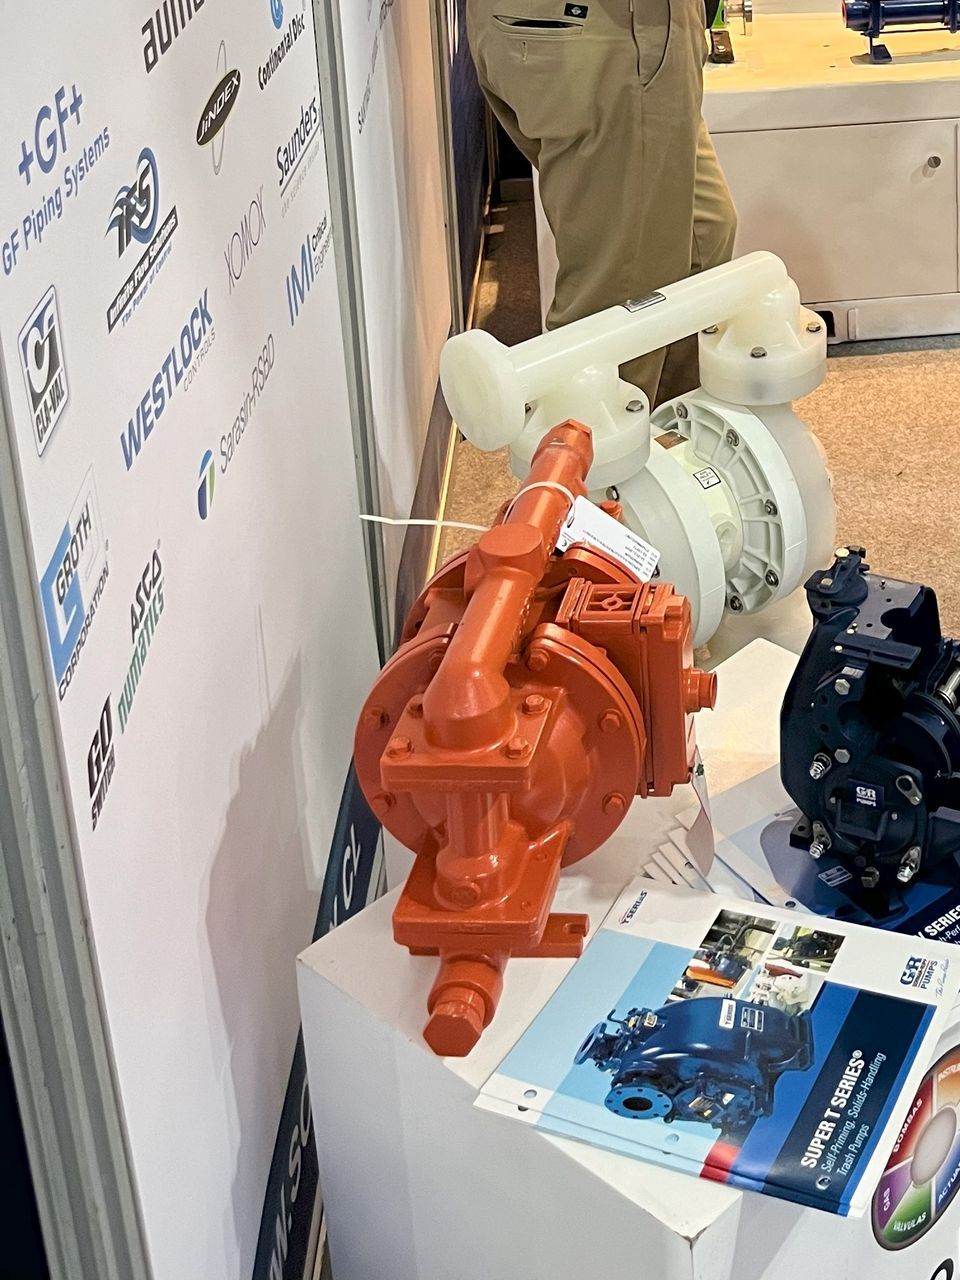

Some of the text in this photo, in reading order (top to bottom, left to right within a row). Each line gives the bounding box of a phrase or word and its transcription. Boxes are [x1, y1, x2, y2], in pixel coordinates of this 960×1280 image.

[276, 97, 318, 187] Saunders
[2, 126, 110, 276] GF Piping Systems
[286, 234, 315, 327] IMI
[120, 287, 213, 472] WESTLOCK
[183, 328, 217, 393] CONTROLS
[220, 333, 275, 474] Sarasin-RSBD
[55, 502, 92, 606] GROTH
[130, 549, 163, 644] ASCO
[58, 561, 110, 702] CORPORATION
[87, 692, 113, 800] GO
[920, 960, 938, 990] PUMPS
[800, 1120, 837, 1169] SUPER
[824, 1108, 841, 1119] T
[821, 1052, 887, 1172] Self-Priming, Solids-Handling
[836, 1123, 870, 1176] Trash Pumps
[883, 1187, 891, 1212] GAS
